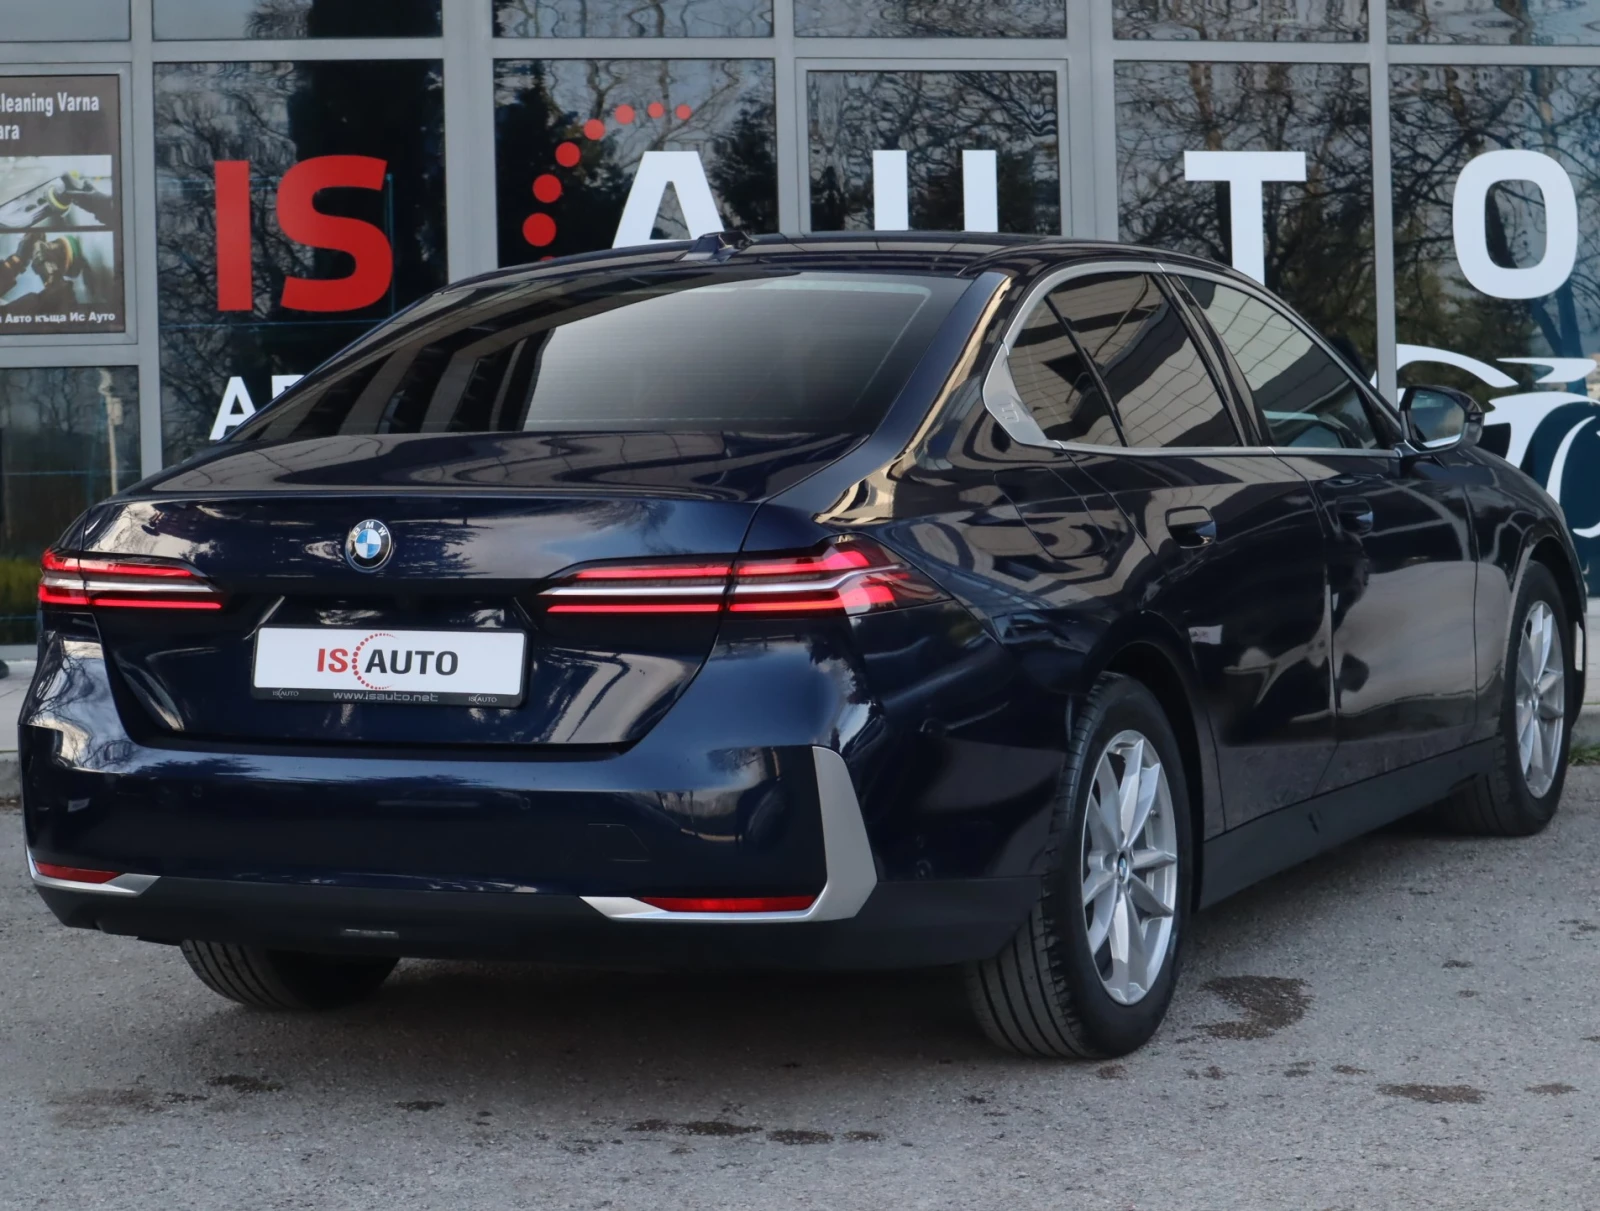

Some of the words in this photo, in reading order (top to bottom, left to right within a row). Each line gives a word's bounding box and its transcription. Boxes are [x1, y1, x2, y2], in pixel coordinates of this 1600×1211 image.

[0, 92, 54, 117] leaning
[57, 91, 100, 112] Varna
[214, 154, 393, 312] IS
[5, 313, 32, 323] Авто
[35, 314, 67, 323] къща
[69, 312, 86, 322] Ис
[88, 311, 116, 323] Ауто
[353, 521, 388, 537] BMW
[333, 690, 439, 702] www.isauto.net
